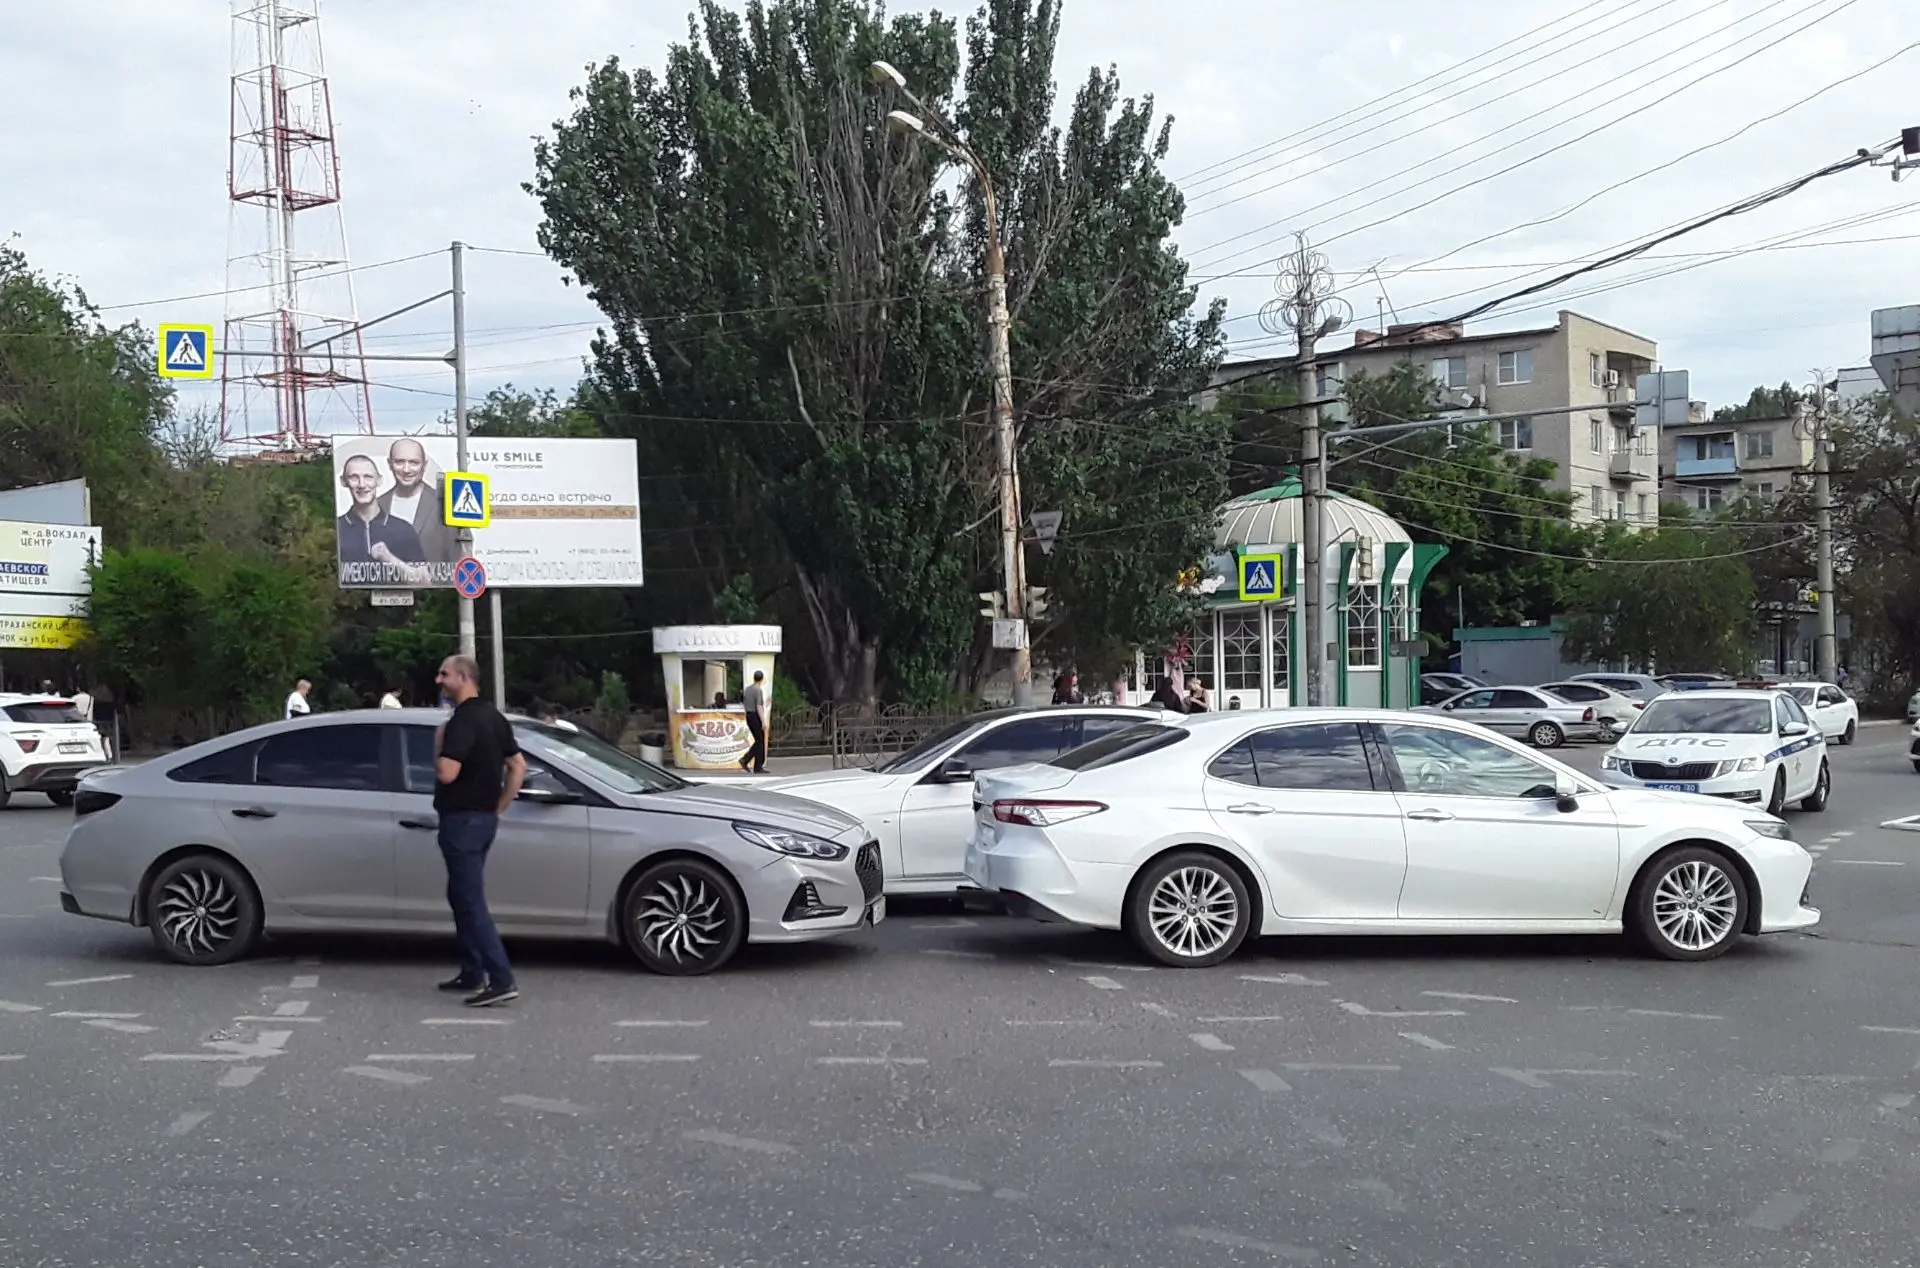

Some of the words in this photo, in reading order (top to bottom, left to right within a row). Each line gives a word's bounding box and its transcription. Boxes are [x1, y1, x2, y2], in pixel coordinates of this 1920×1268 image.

[473, 452, 499, 462] LUX
[503, 452, 543, 462] SMILE
[487, 493, 517, 503] огда
[521, 493, 555, 503] одна
[559, 494, 612, 505] встреча
[20, 537, 53, 548] ЦЕНТР
[1636, 737, 1729, 748] ДПС
